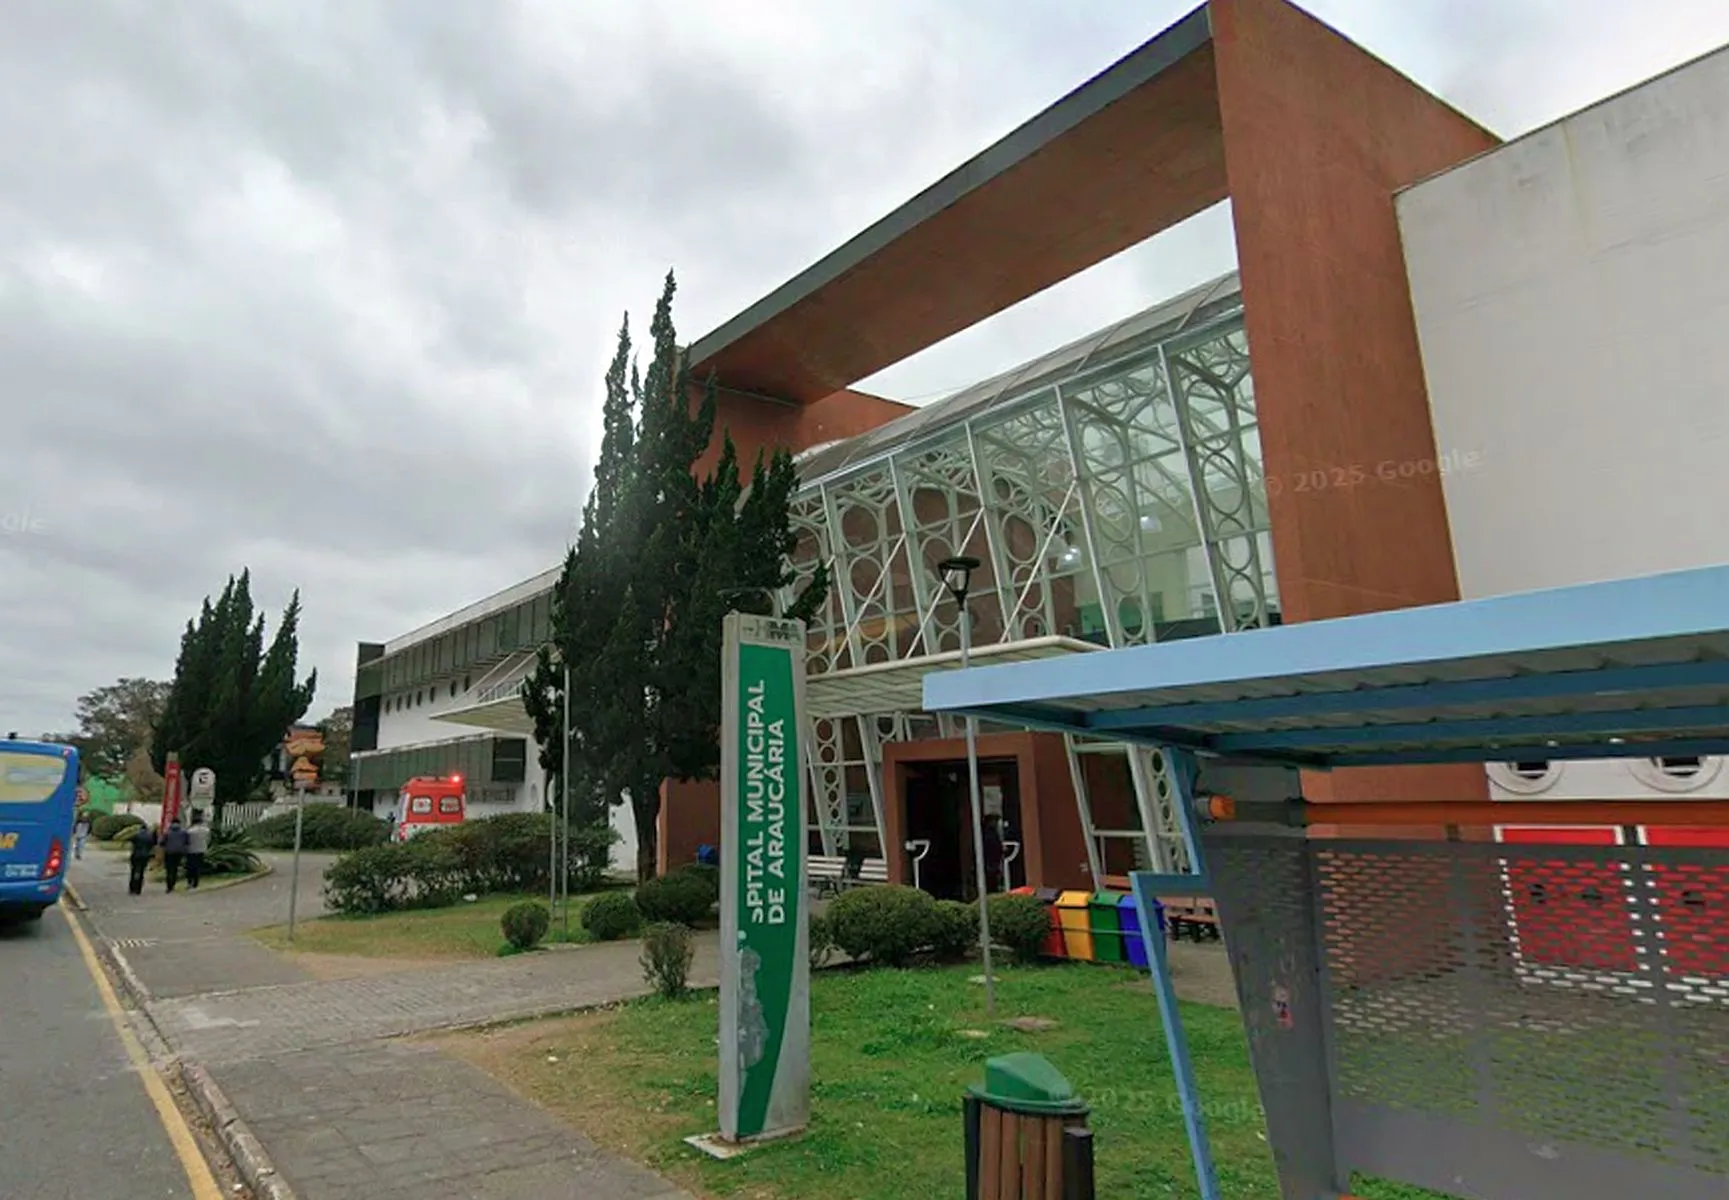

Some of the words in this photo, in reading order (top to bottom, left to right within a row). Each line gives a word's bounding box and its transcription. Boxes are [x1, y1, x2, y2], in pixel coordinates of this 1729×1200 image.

[746, 679, 765, 822] MUNICIPAL
[763, 718, 785, 879] ARAUCÁRIA
[767, 887, 785, 924] DE
